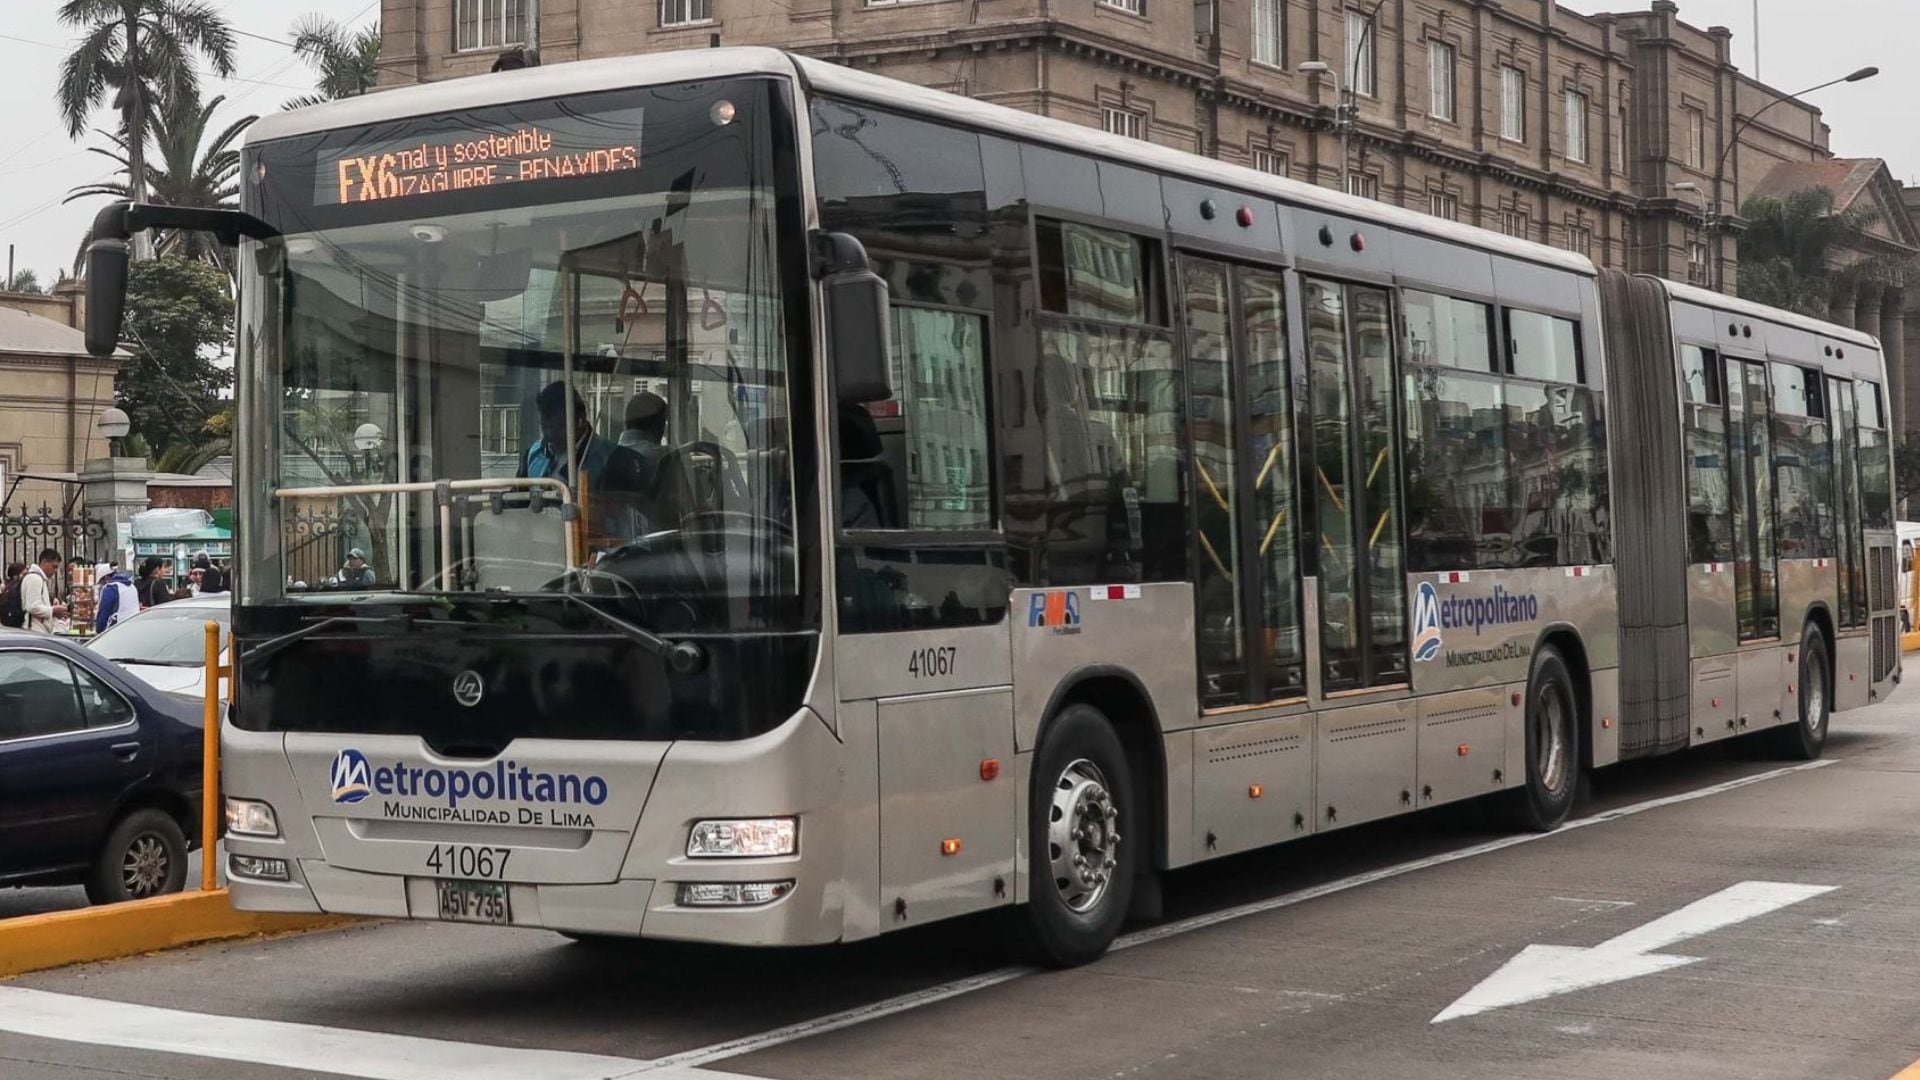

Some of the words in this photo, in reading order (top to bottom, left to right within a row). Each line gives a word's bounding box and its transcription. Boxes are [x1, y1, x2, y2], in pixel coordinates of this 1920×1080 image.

[435, 145, 448, 171] y
[453, 128, 552, 163] sostenible
[1412, 581, 1537, 655] Metropolitano
[908, 647, 957, 679] 41067
[330, 748, 608, 807] Metropolitano
[384, 801, 511, 825] MUNICIPALIDAD
[426, 844, 512, 880] 41067
